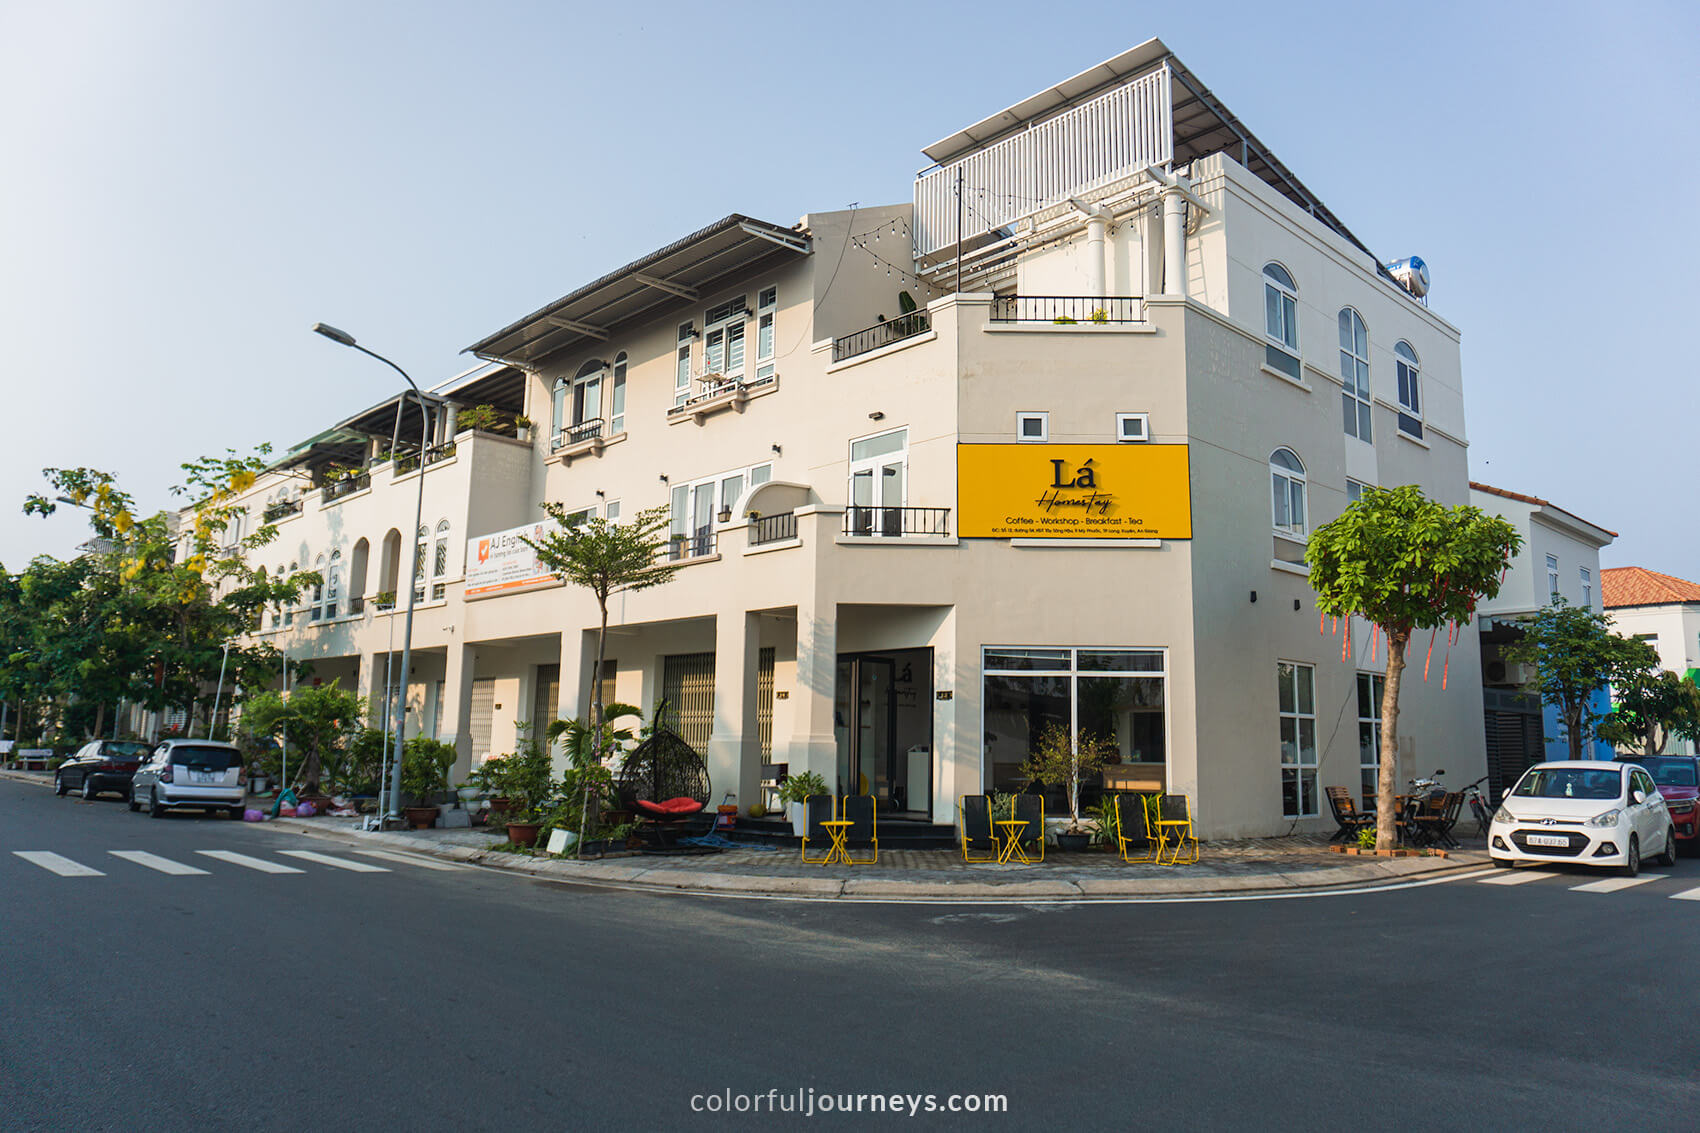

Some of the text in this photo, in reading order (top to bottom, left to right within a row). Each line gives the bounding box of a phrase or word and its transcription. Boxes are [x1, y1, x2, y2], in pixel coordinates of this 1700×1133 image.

[1050, 458, 1096, 488] Lá
[1035, 490, 1113, 514] Homestay
[1005, 516, 1034, 525] Coffee
[1040, 517, 1080, 526] Workshop
[1085, 517, 1122, 525] Breakfast
[1128, 517, 1143, 525] Tea
